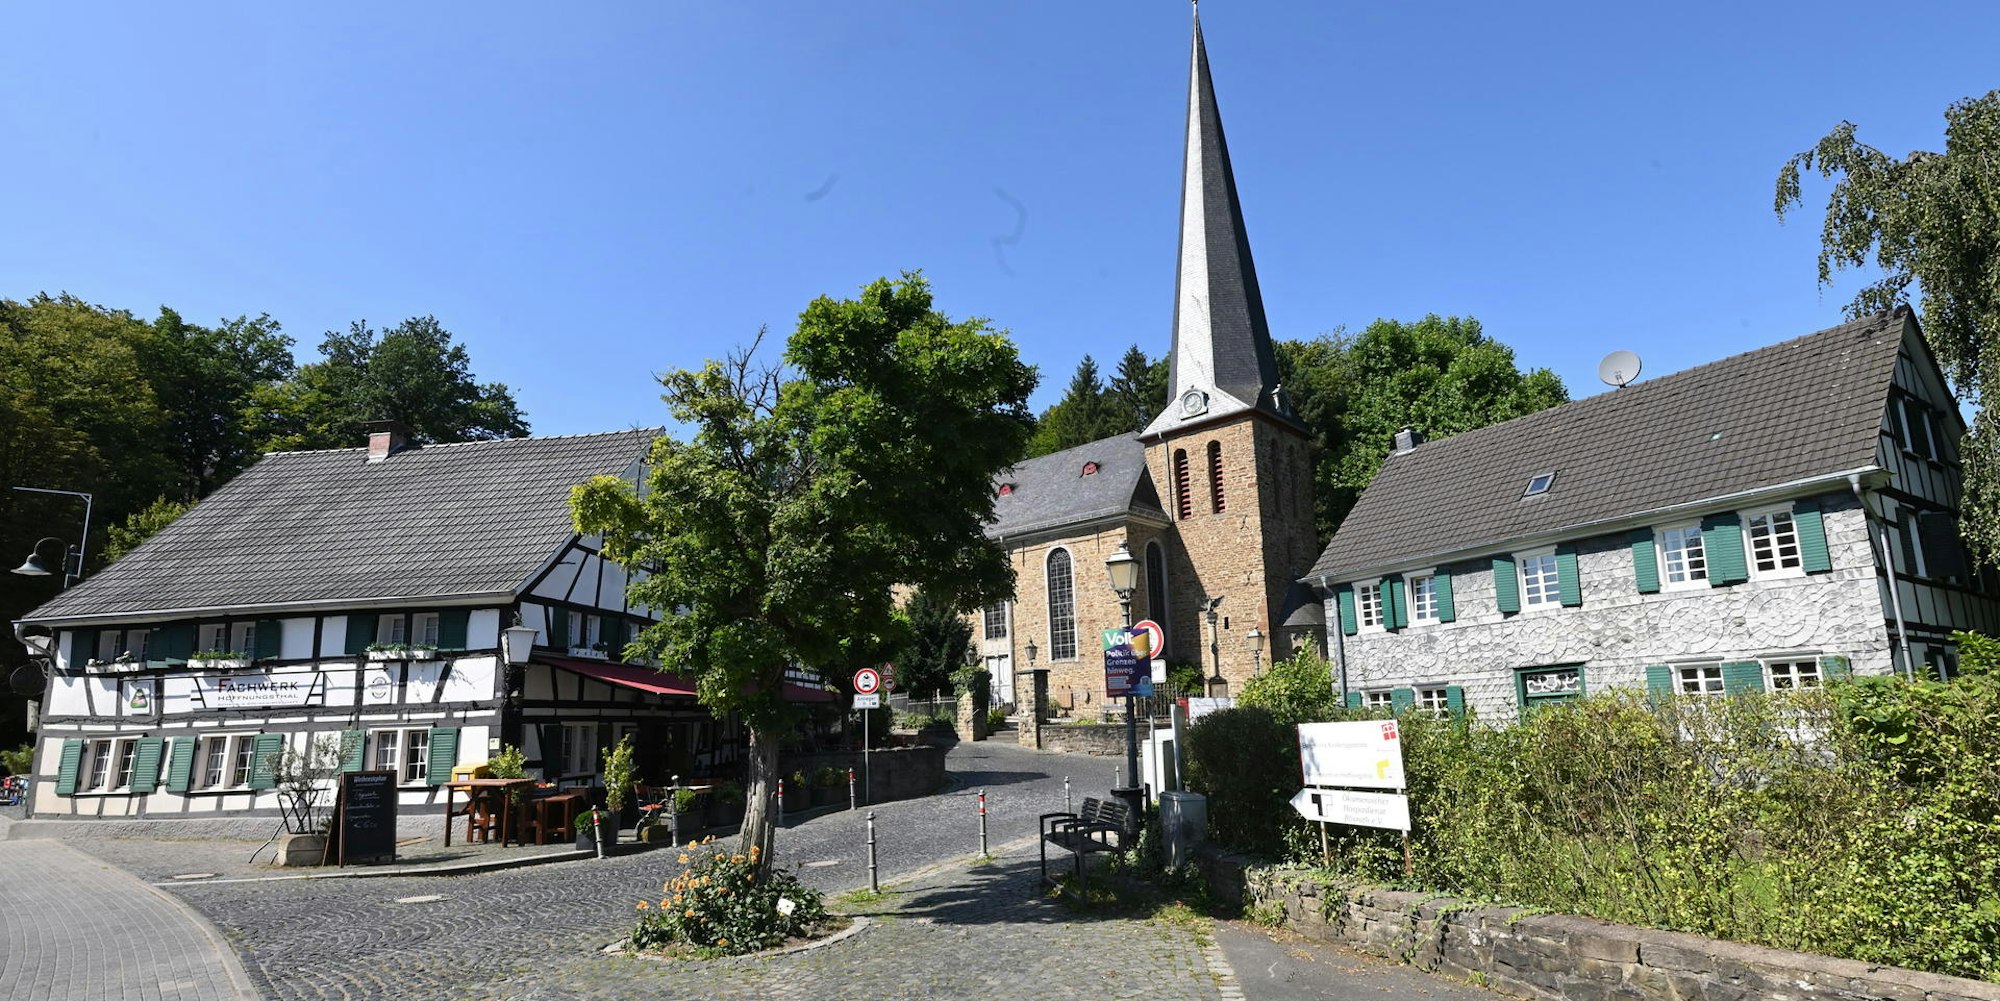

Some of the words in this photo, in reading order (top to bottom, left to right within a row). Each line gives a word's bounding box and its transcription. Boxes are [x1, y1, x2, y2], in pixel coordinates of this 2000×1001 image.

[1105, 632, 1135, 645] Volt
[1106, 649, 1130, 658] Politik
[1106, 667, 1136, 675] hinweg.
[218, 678, 298, 693] FACHWERK
